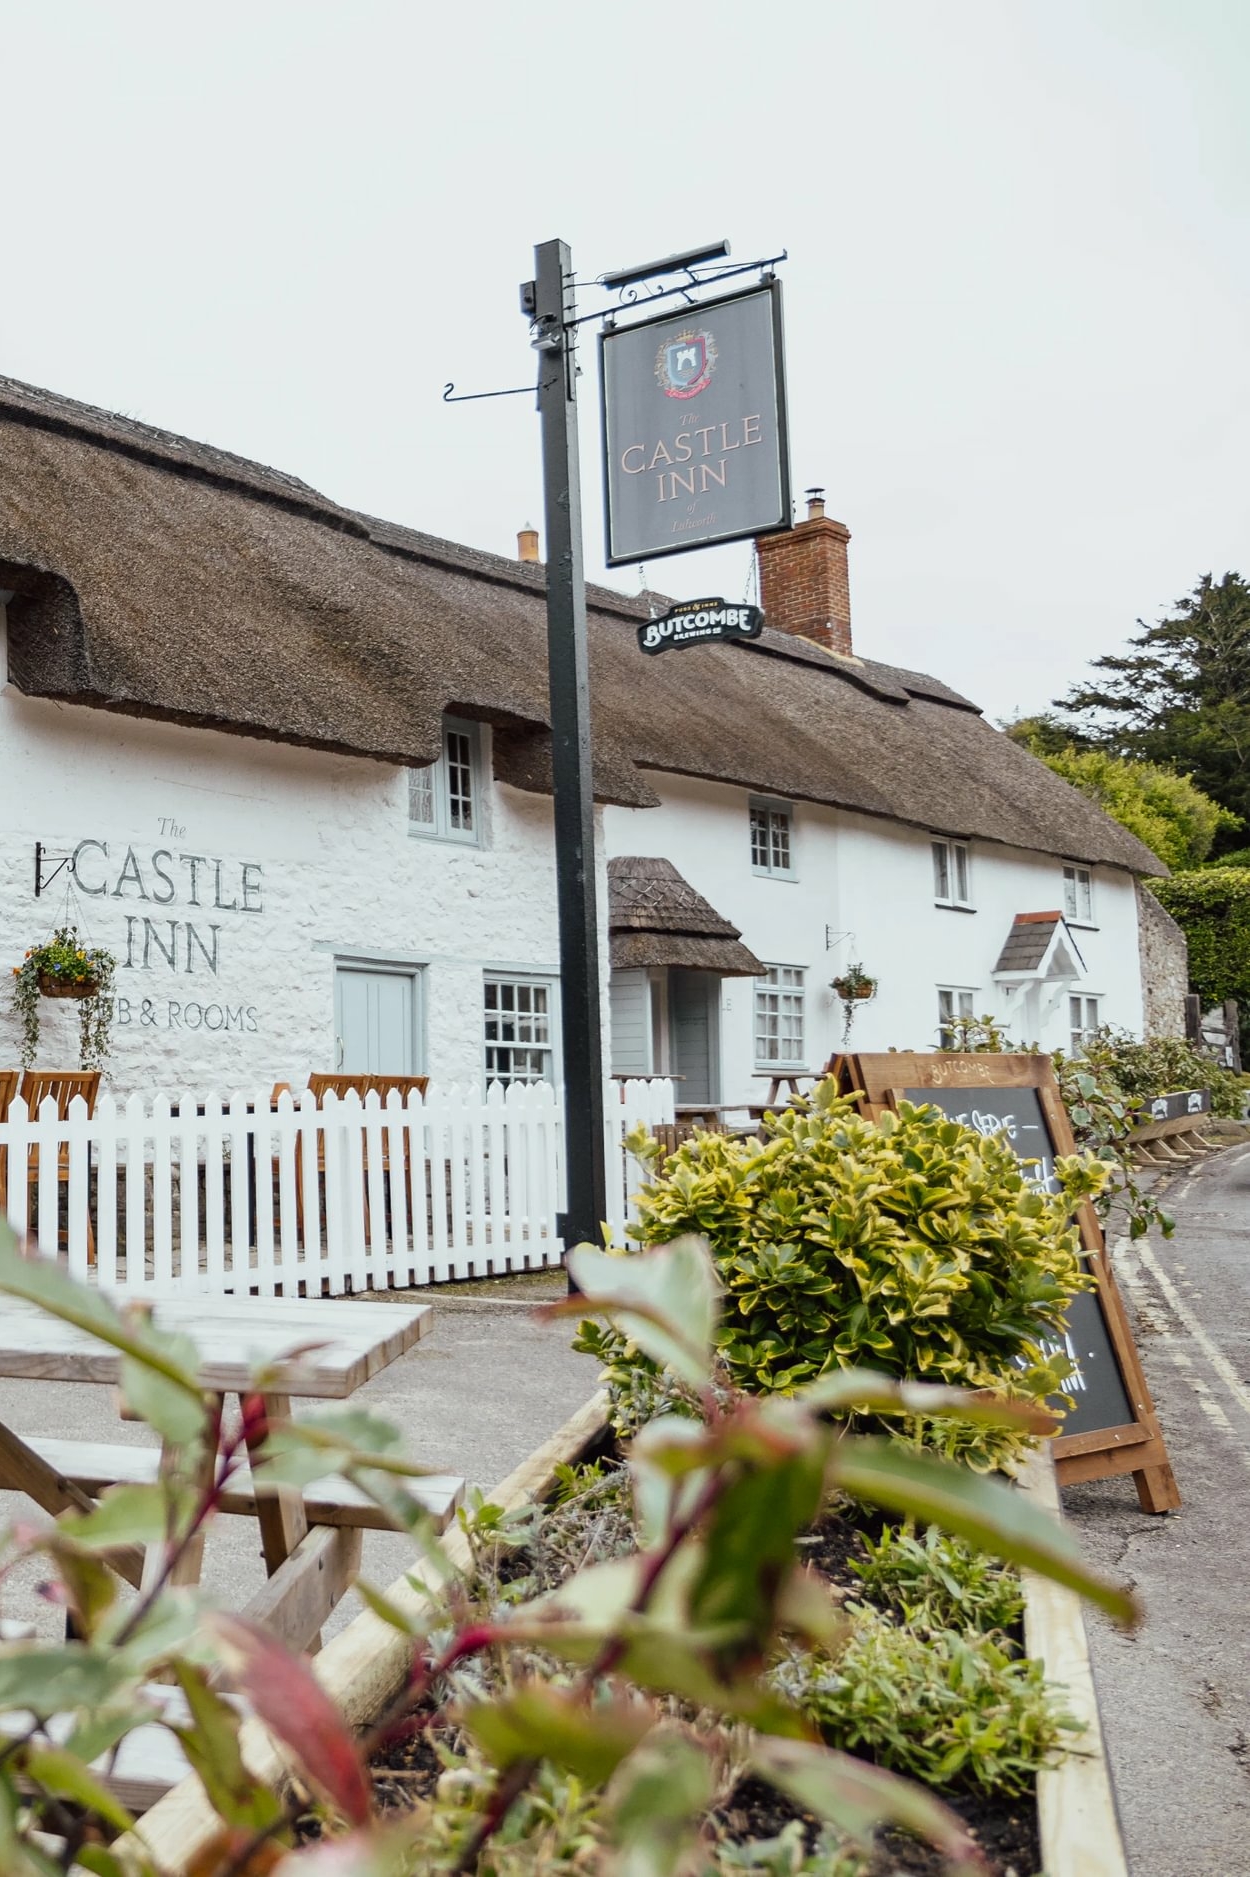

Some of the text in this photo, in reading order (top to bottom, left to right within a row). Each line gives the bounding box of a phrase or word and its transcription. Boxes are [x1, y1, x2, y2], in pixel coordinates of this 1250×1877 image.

[621, 414, 763, 474] CASTLE
[656, 458, 728, 503] INN
[643, 608, 751, 647] BUTCOMBE
[158, 817, 187, 839] The
[71, 839, 264, 914] CASTLE
[122, 915, 221, 976] INN
[139, 998, 159, 1027] &
[168, 1000, 259, 1033] ROOMS
[930, 1060, 996, 1085] BUTCOMBE
